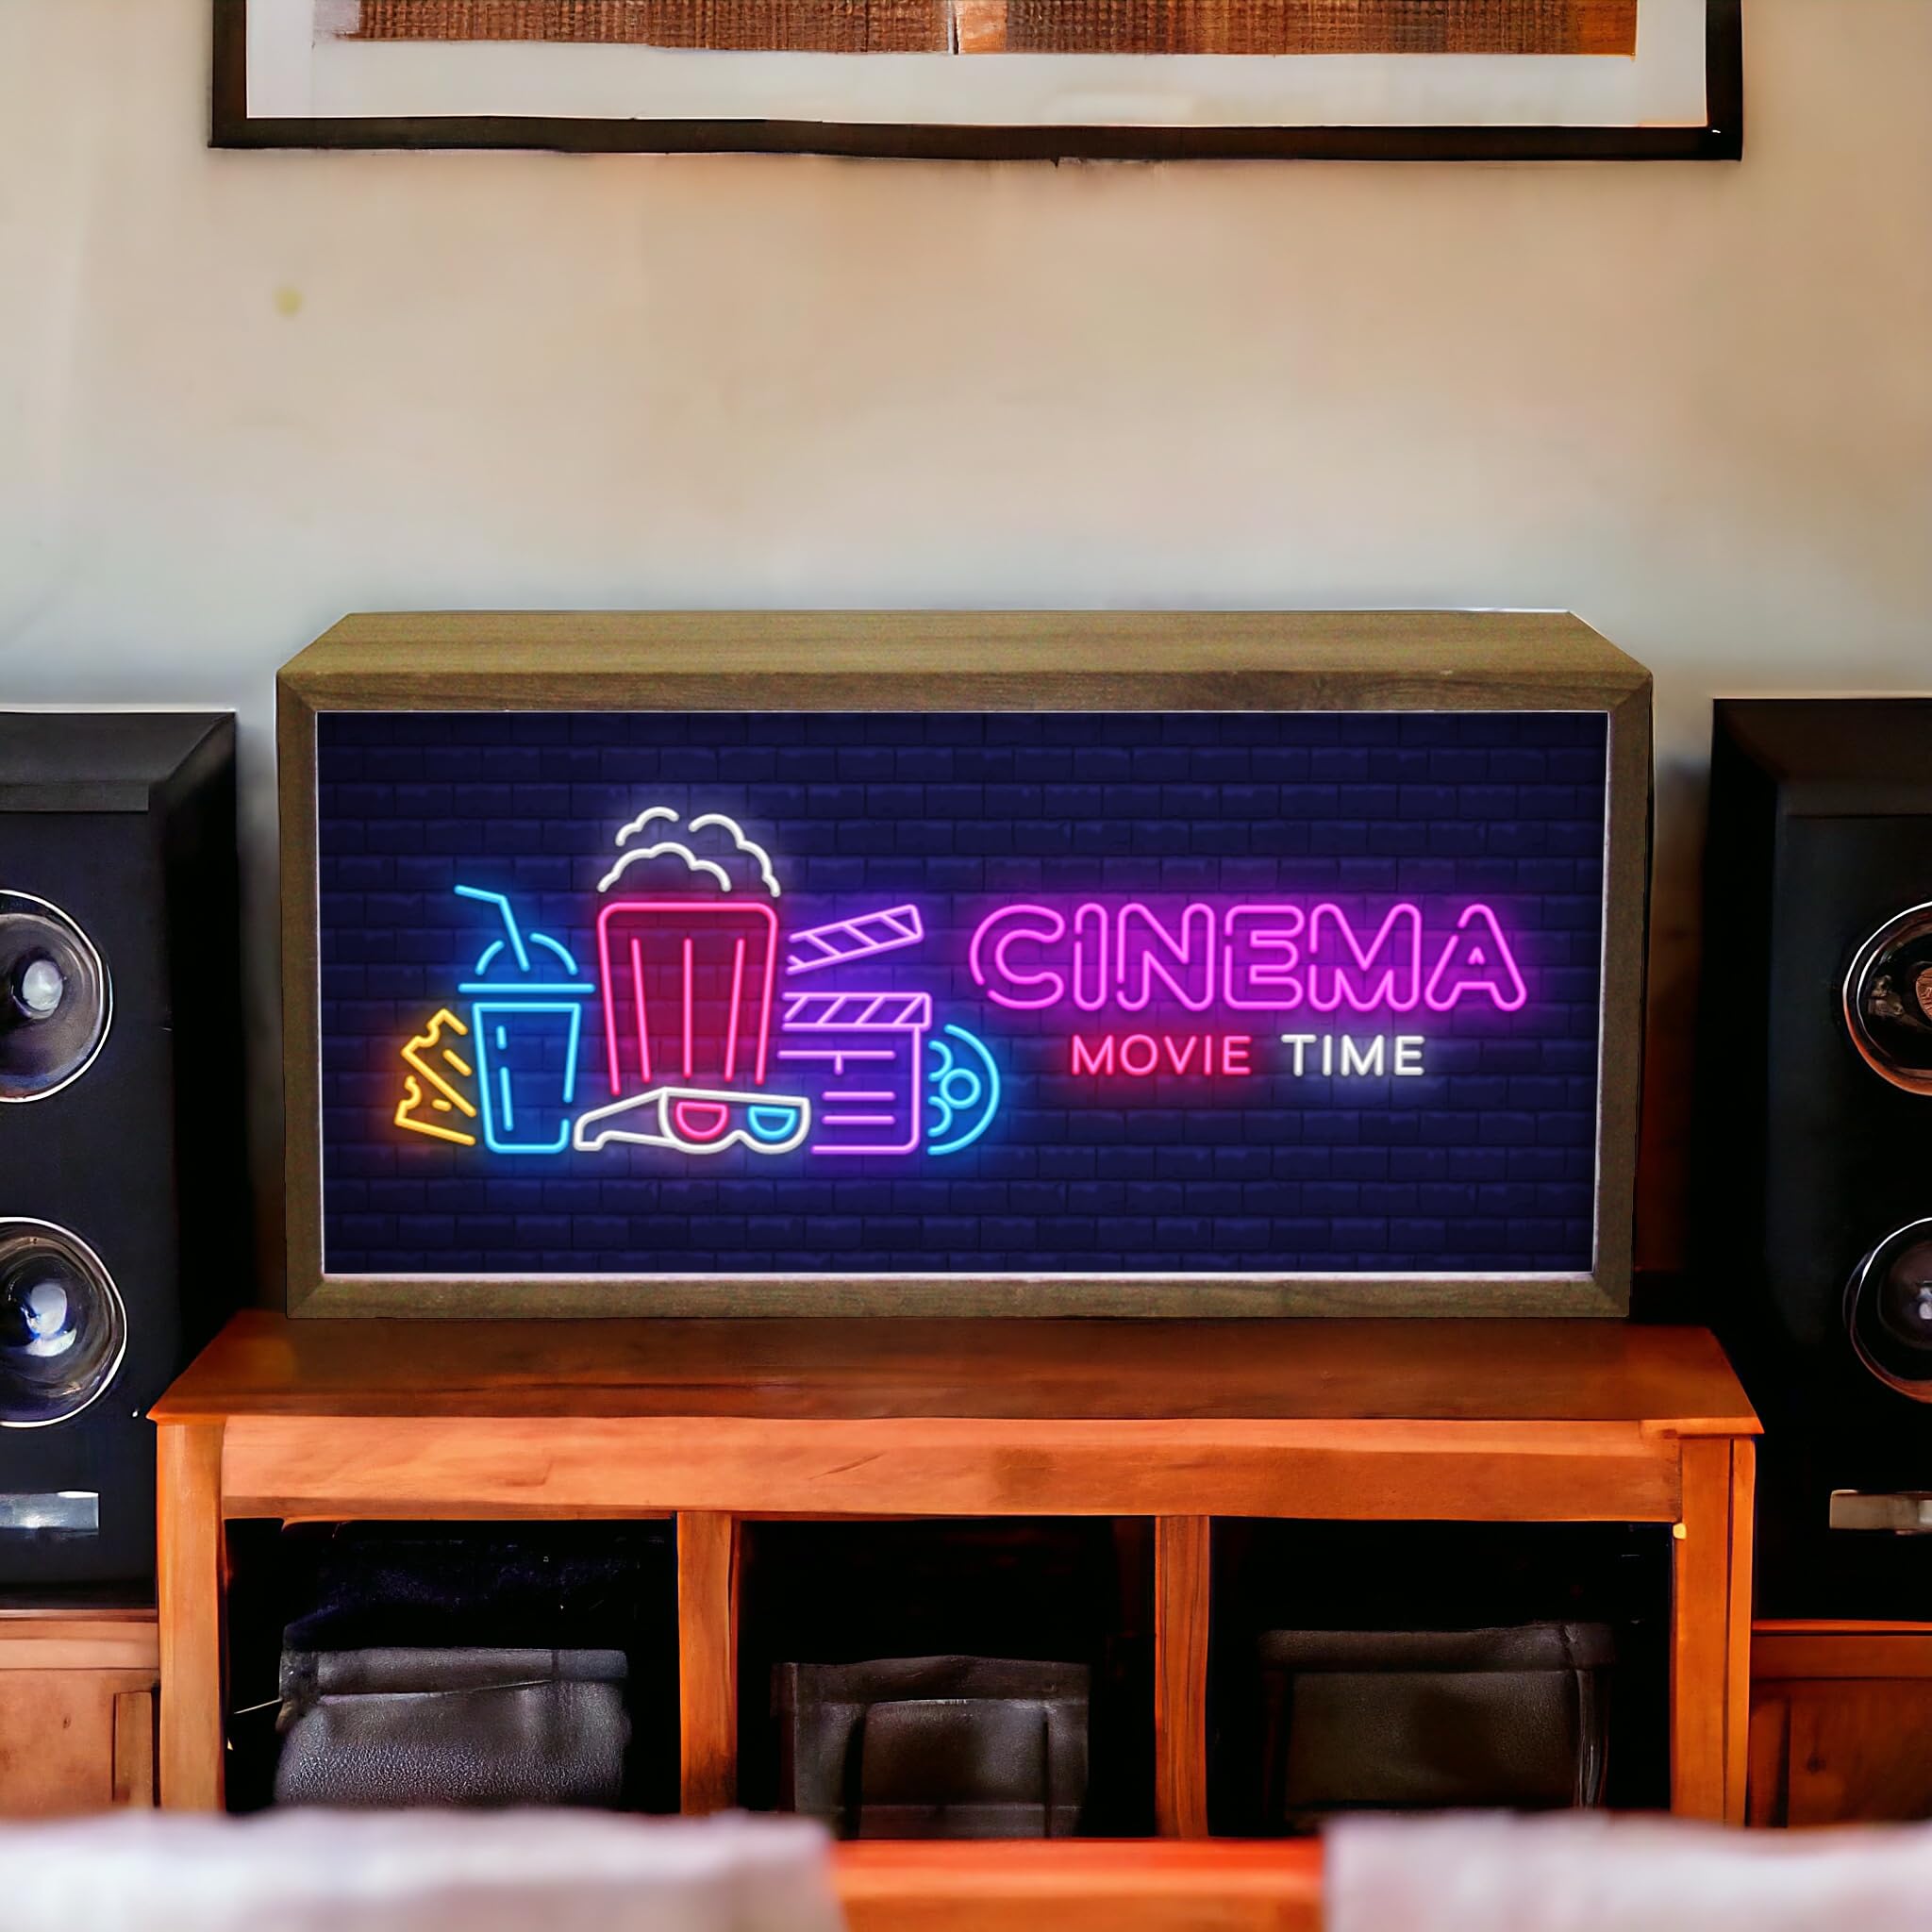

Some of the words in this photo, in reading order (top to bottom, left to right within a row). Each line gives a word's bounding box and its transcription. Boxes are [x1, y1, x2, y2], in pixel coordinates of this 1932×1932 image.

[969, 902, 1527, 1012] CINEMA
[1071, 1034, 1253, 1076] MOVIE
[1280, 1034, 1426, 1077] TIME
